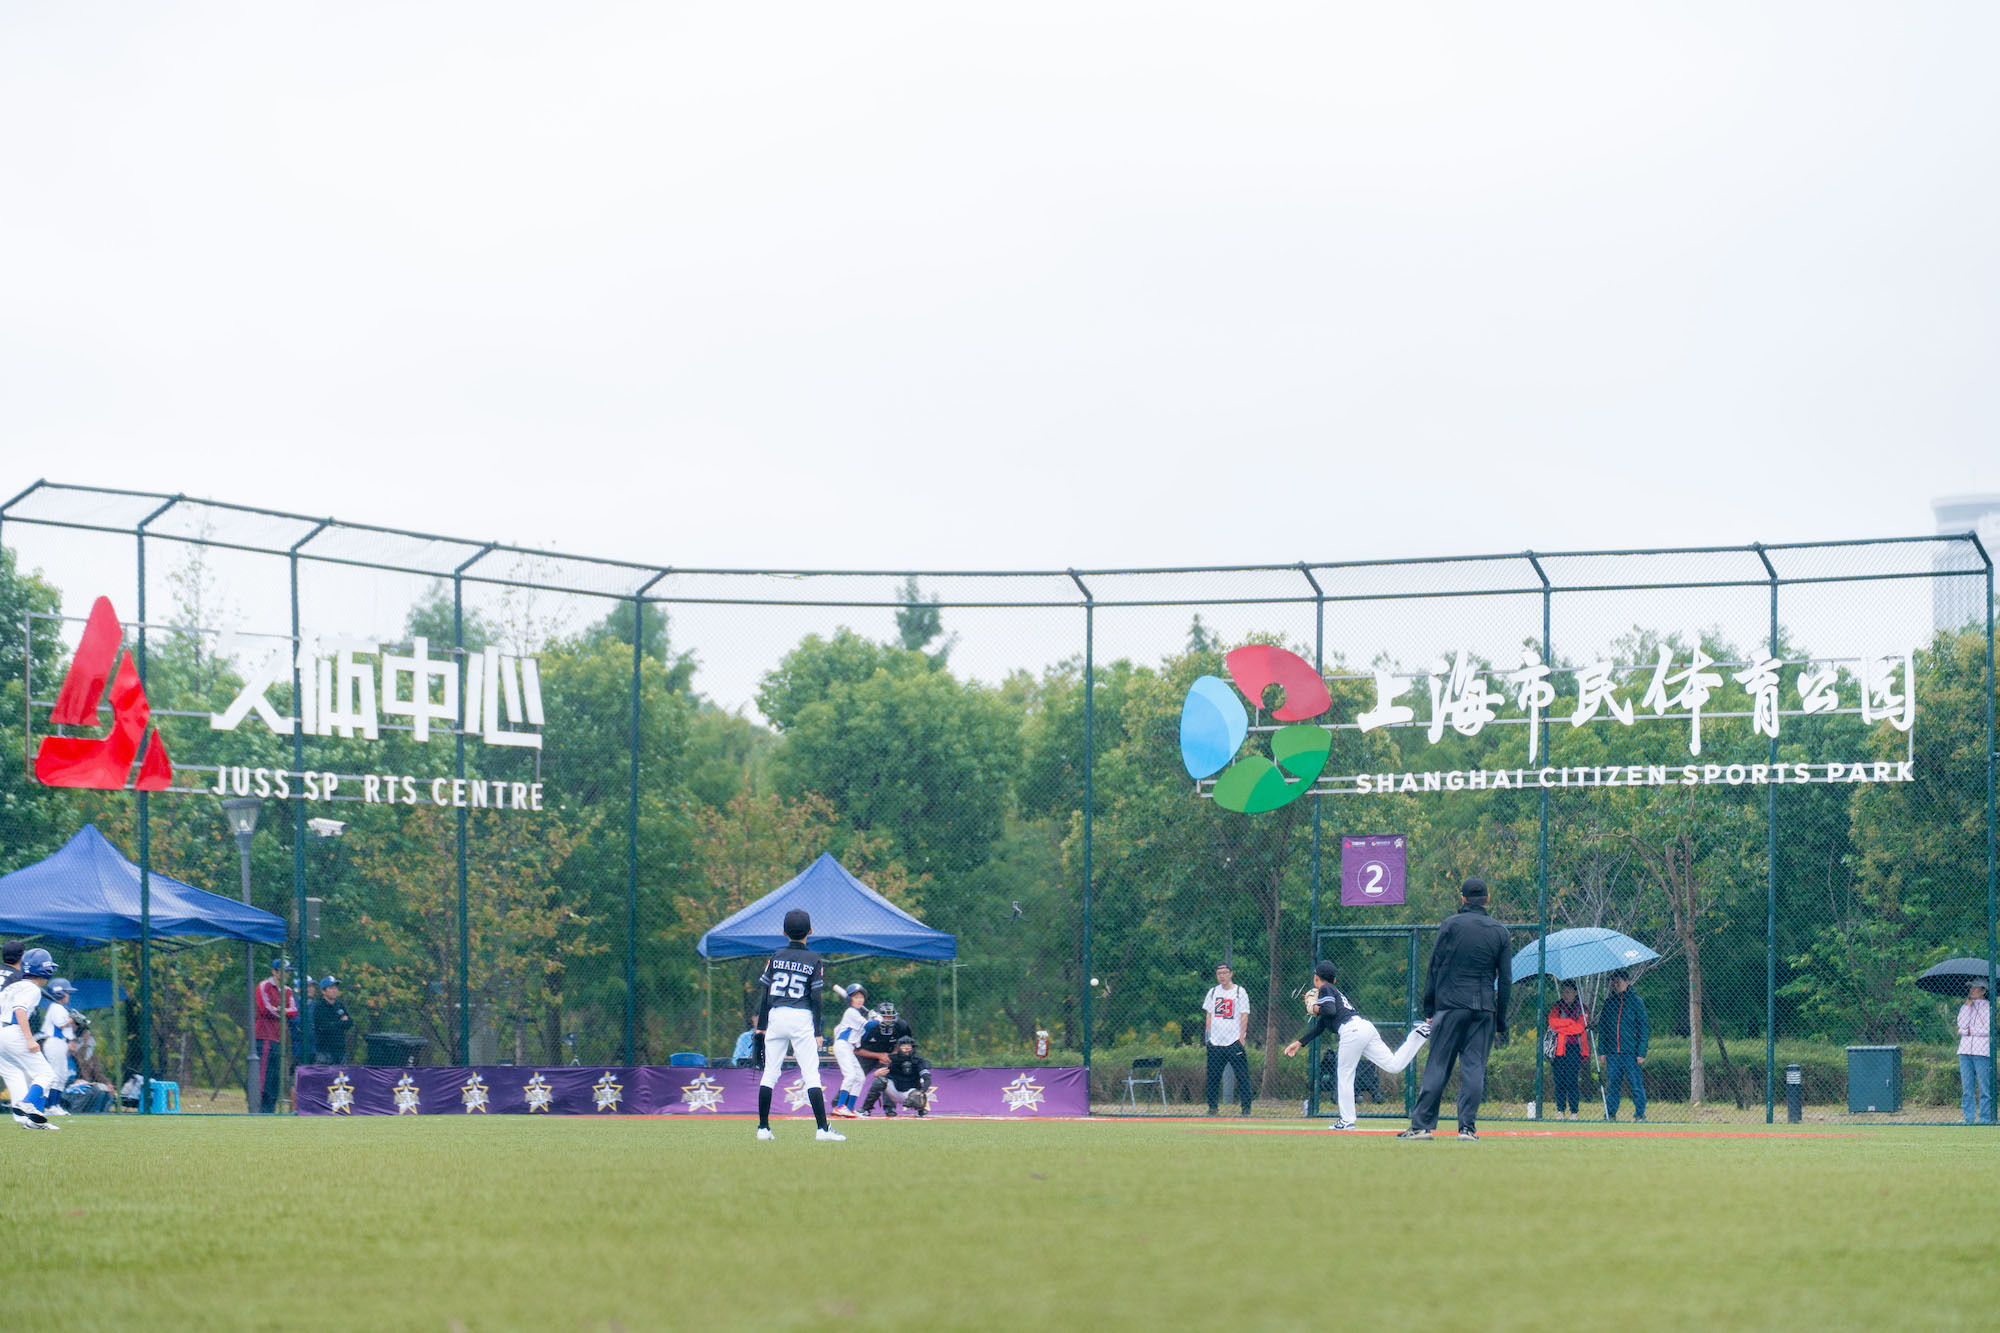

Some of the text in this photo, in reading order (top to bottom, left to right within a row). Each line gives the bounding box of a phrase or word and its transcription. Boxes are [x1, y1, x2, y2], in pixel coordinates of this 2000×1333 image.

[1356, 641, 1917, 765] 上海市民体育公园
[211, 766, 290, 799] JUSS
[431, 777, 544, 811] CENTRE
[1356, 761, 1916, 794] SHANGHAI CITIZEN SPORTS PARK
[1365, 864, 1384, 894] 2
[772, 959, 815, 976] CHARLES
[769, 971, 809, 999] 25
[1214, 996, 1234, 1019] 23
